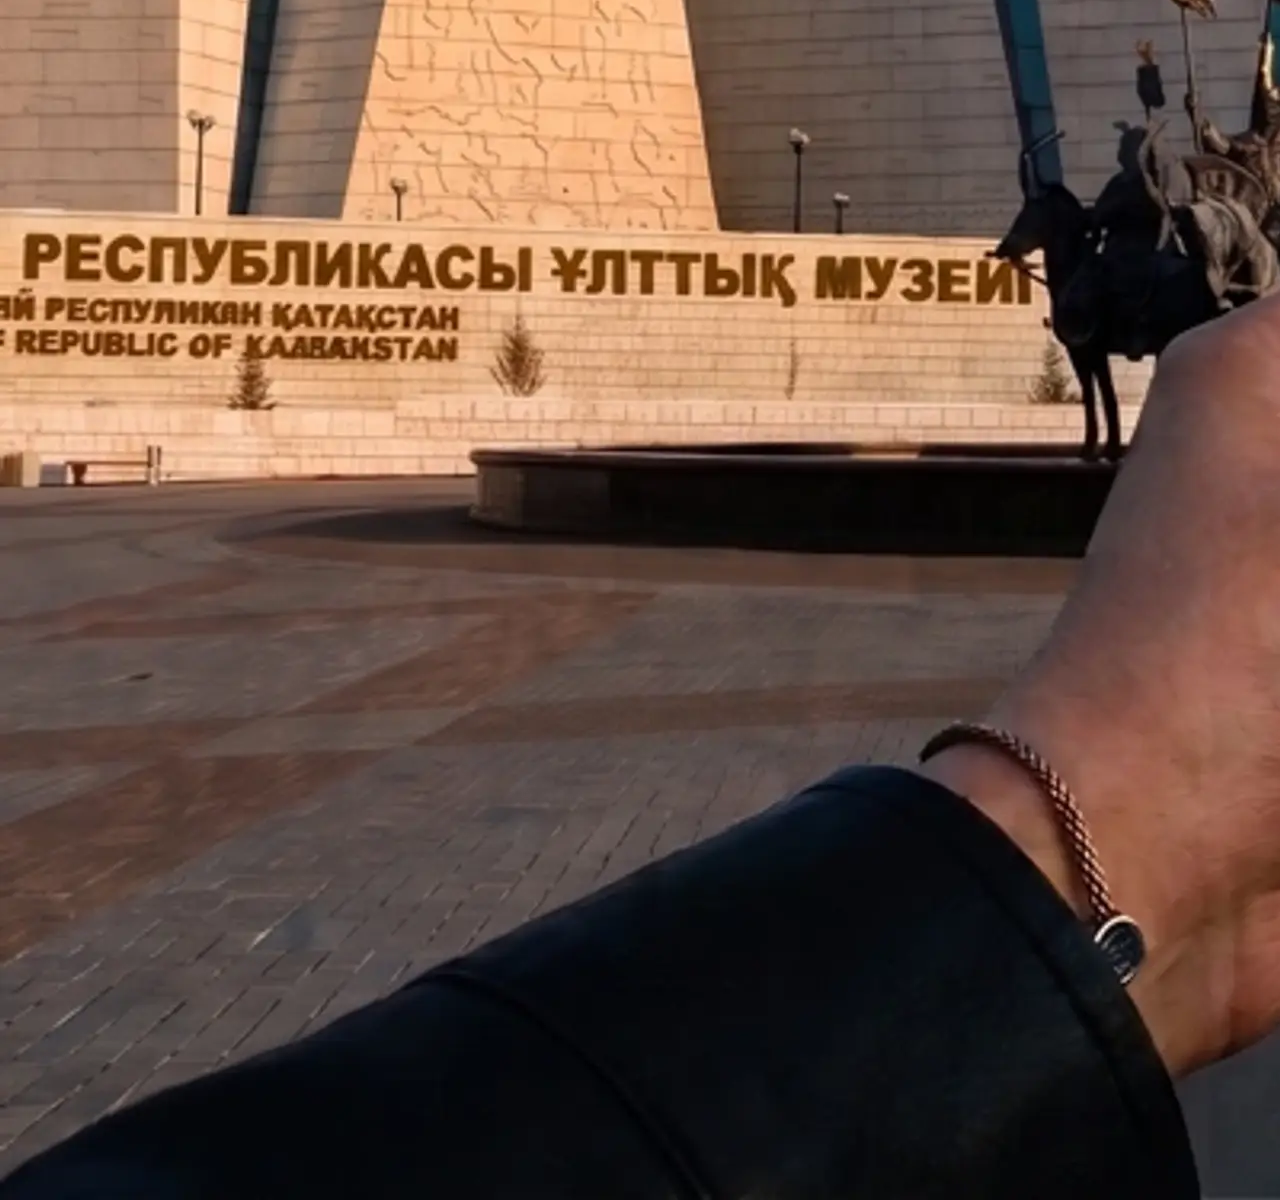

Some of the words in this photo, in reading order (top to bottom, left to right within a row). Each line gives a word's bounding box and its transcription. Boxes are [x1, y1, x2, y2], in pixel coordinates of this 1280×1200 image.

[22, 233, 533, 292] РЕСПУБЛИКАСЫ
[550, 247, 797, 307] ҰЛТТЫҚ
[15, 329, 179, 357] REPUBLIC
[188, 333, 233, 359] OF
